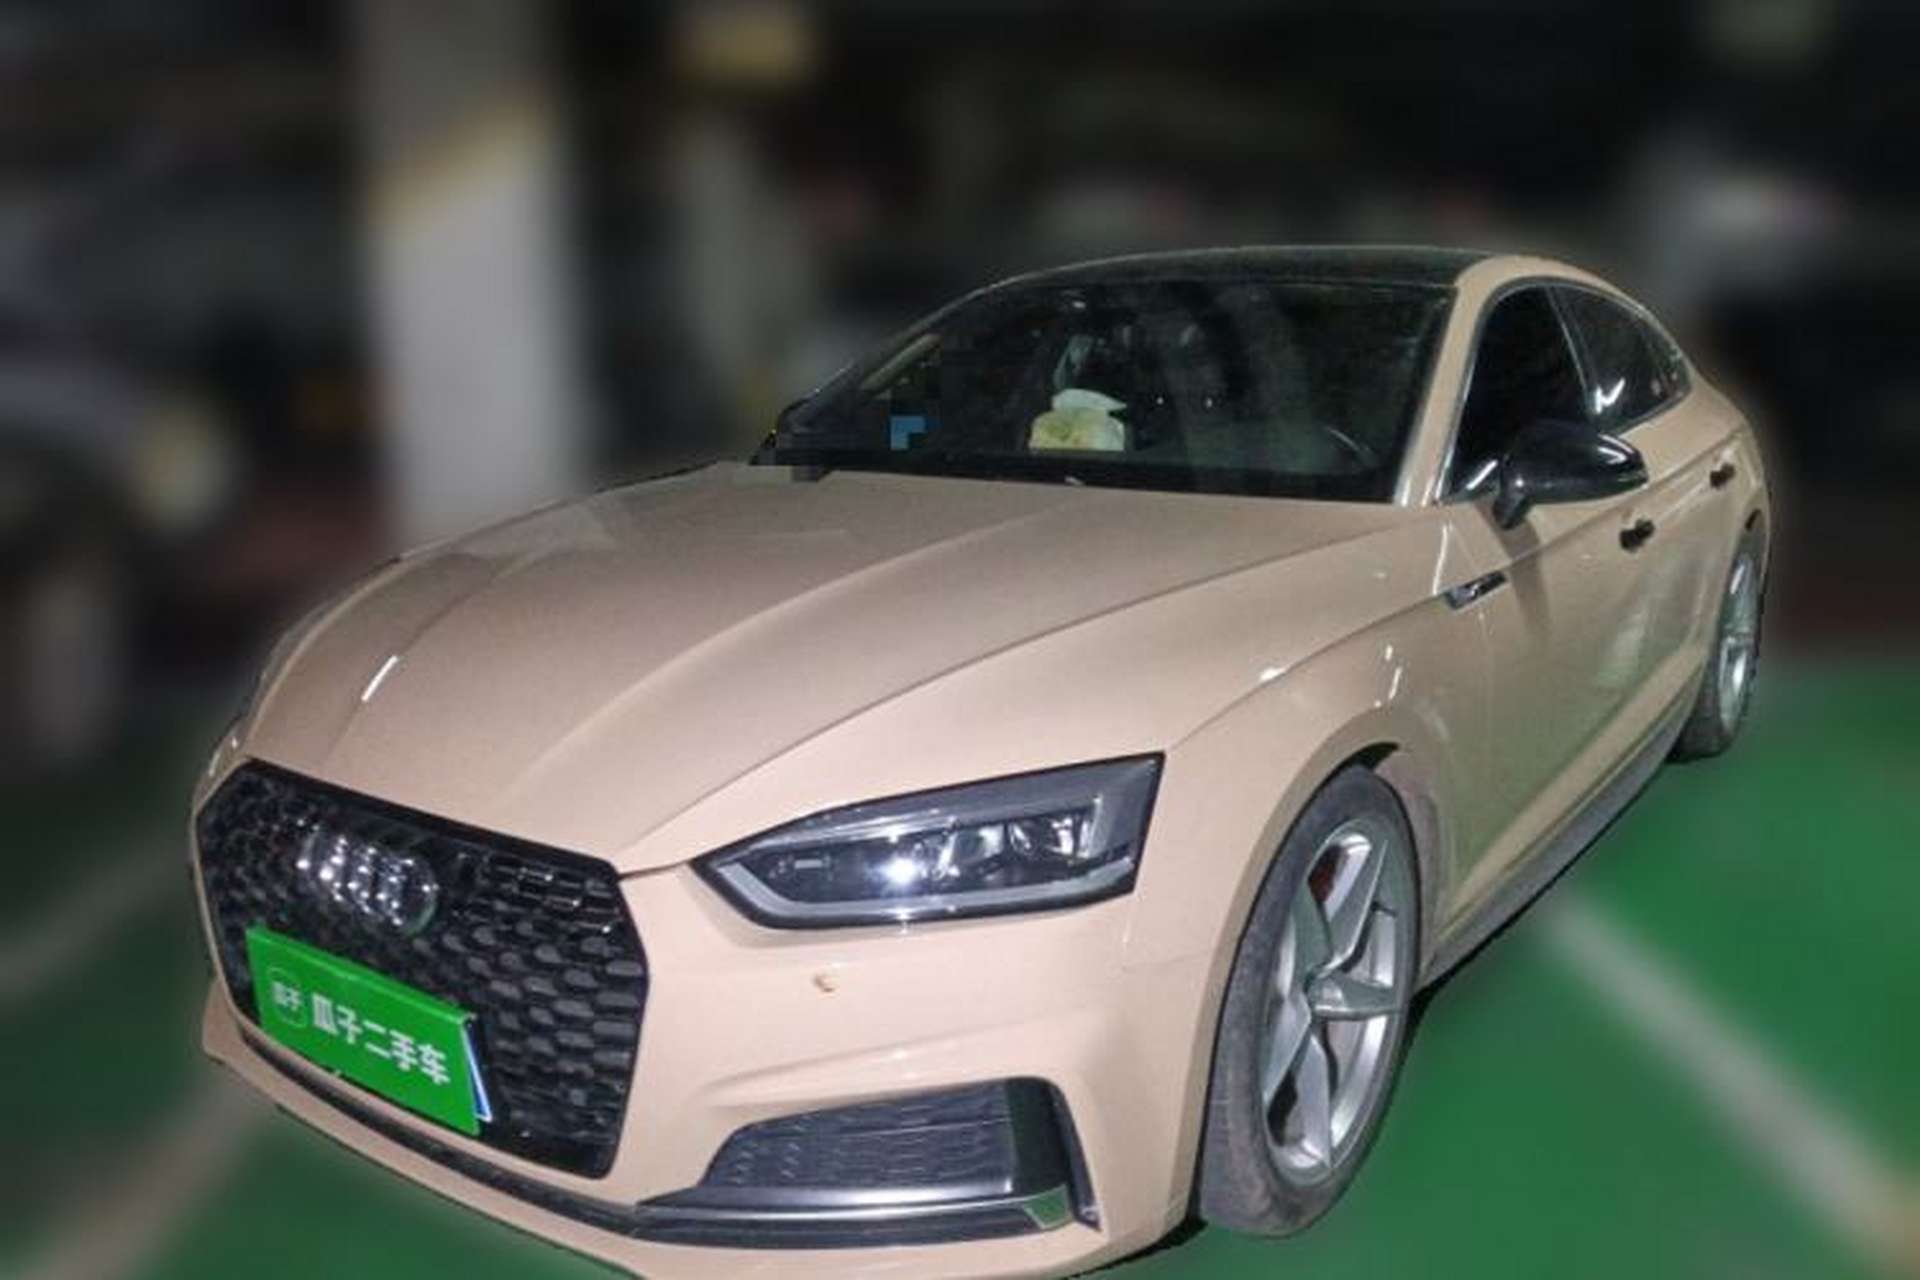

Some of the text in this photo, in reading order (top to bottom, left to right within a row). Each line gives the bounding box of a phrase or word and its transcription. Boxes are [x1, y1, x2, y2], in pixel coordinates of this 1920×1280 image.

[312, 992, 450, 1085] 瓜子二手车
